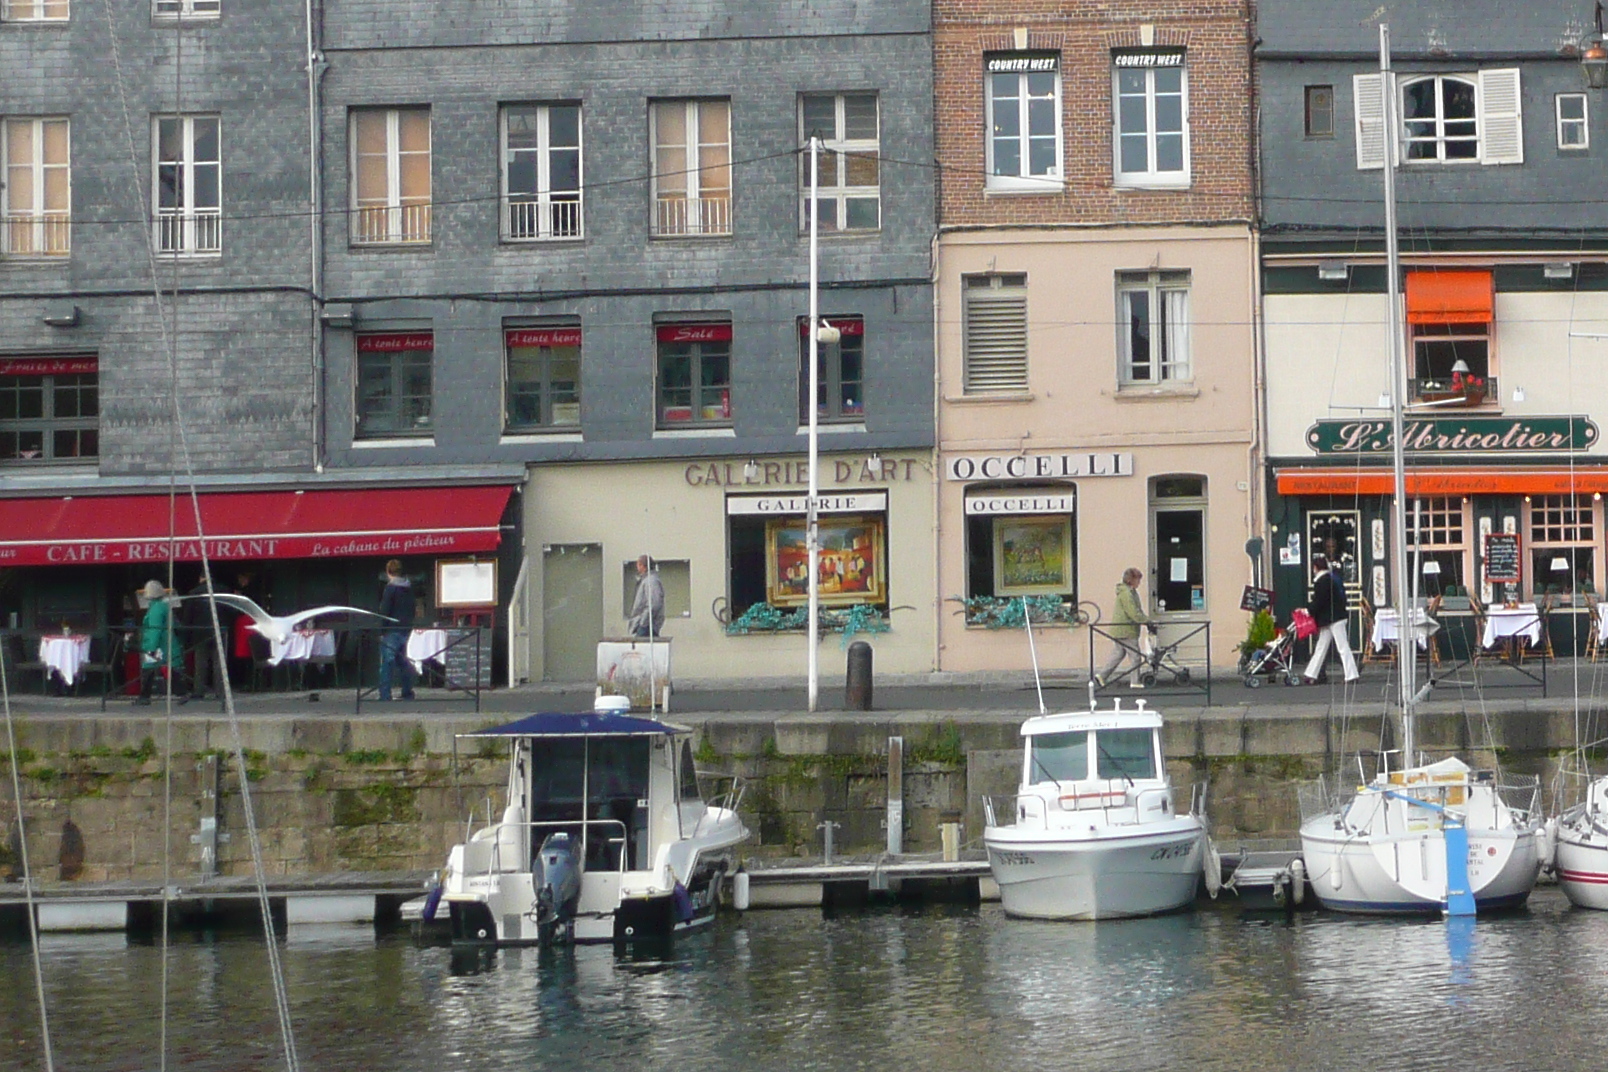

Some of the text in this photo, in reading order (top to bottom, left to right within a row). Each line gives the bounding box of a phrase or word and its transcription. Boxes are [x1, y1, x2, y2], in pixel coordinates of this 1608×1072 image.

[988, 58, 1055, 70] COUNTRY WEST
[1115, 54, 1182, 66] COUNTRY WEST
[1332, 421, 1570, 451] L'Abricotier
[685, 459, 917, 486] GALERIE D'ART
[953, 454, 1121, 479] OCCELLI
[757, 497, 857, 512] GALRIE
[973, 498, 1065, 512] OCCELLI
[128, 539, 279, 560] RESTAURANT
[311, 534, 456, 556] La cabane du pêcheur
